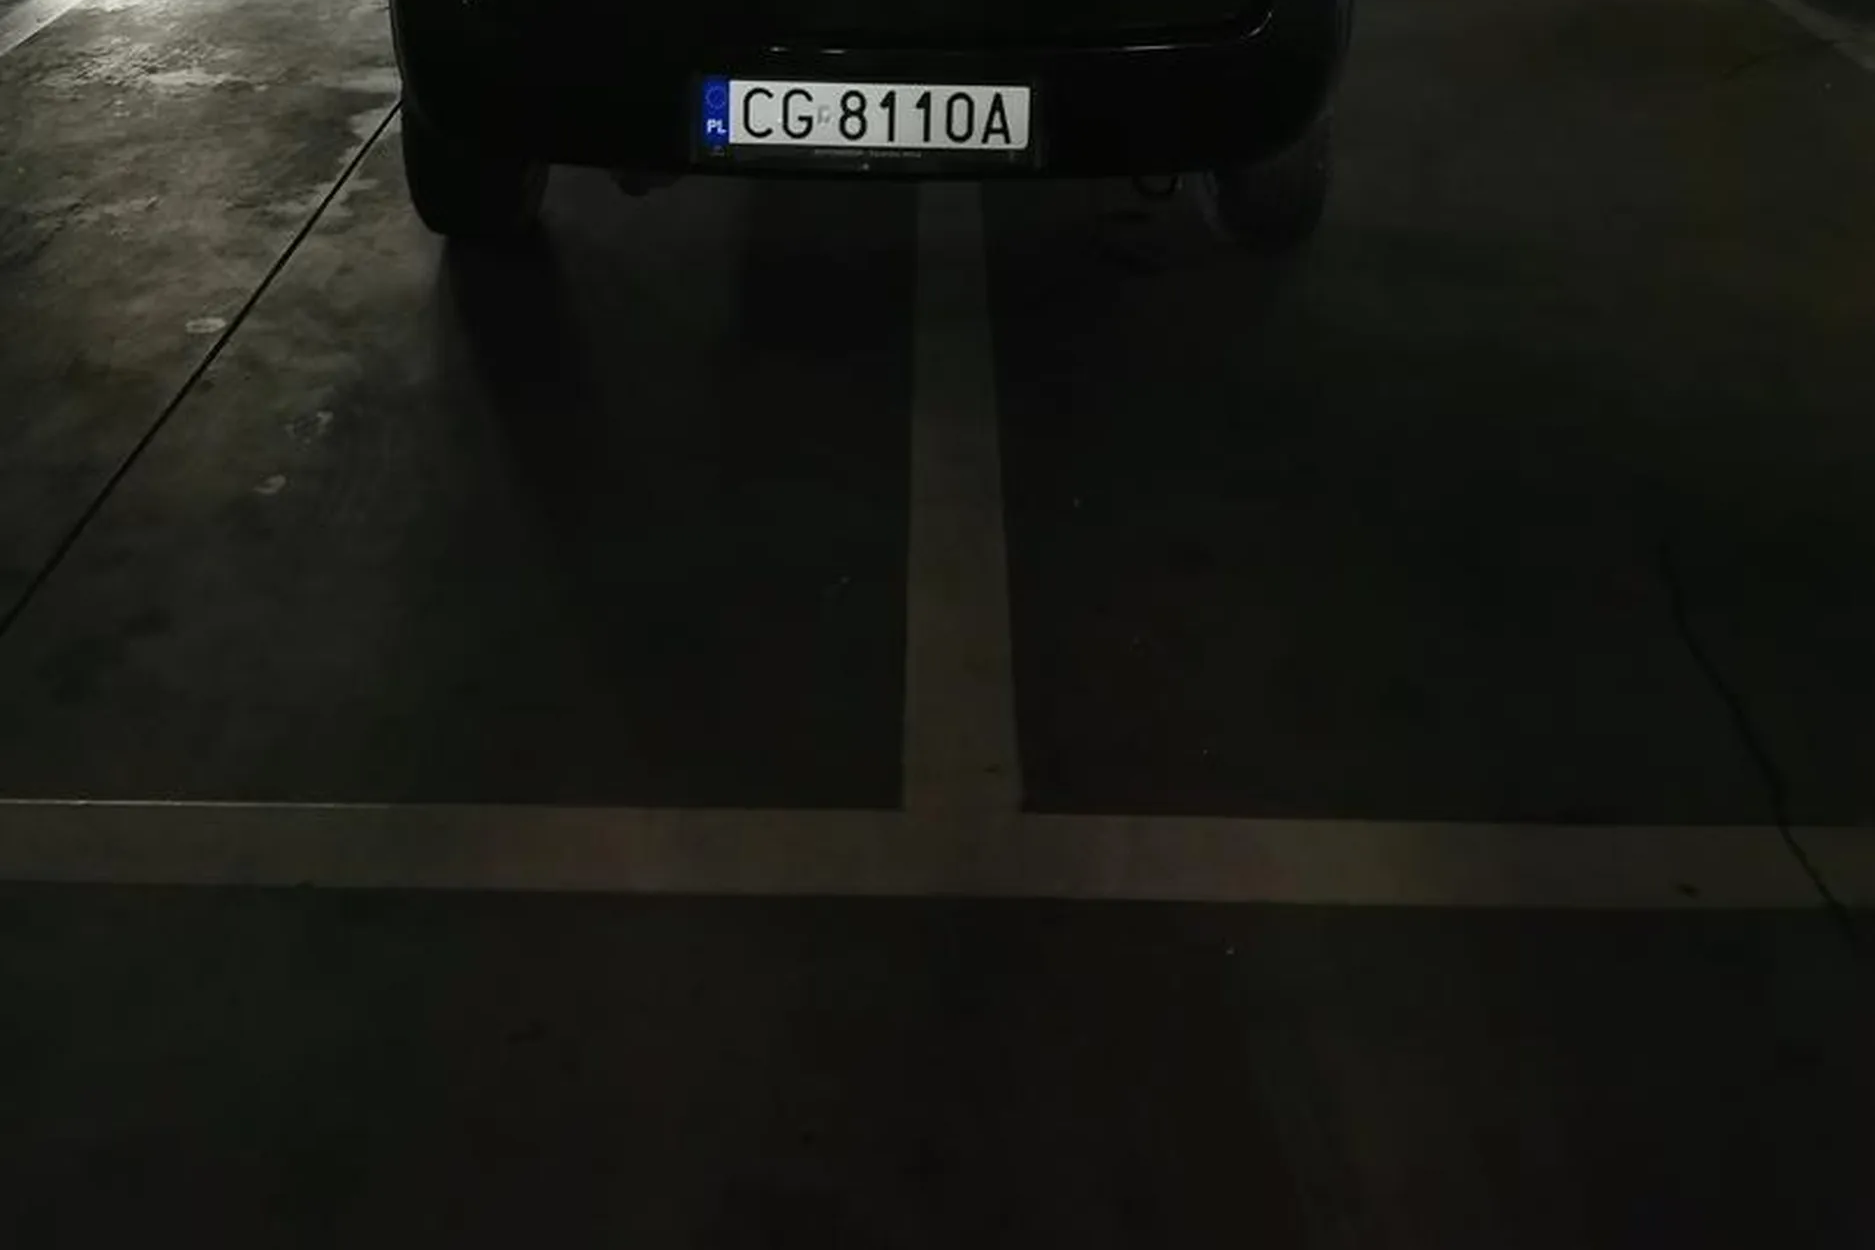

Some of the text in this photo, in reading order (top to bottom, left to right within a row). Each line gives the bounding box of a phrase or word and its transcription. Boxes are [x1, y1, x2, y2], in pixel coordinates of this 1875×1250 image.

[706, 118, 727, 134] PL
[743, 87, 1011, 144] CG 8110A
